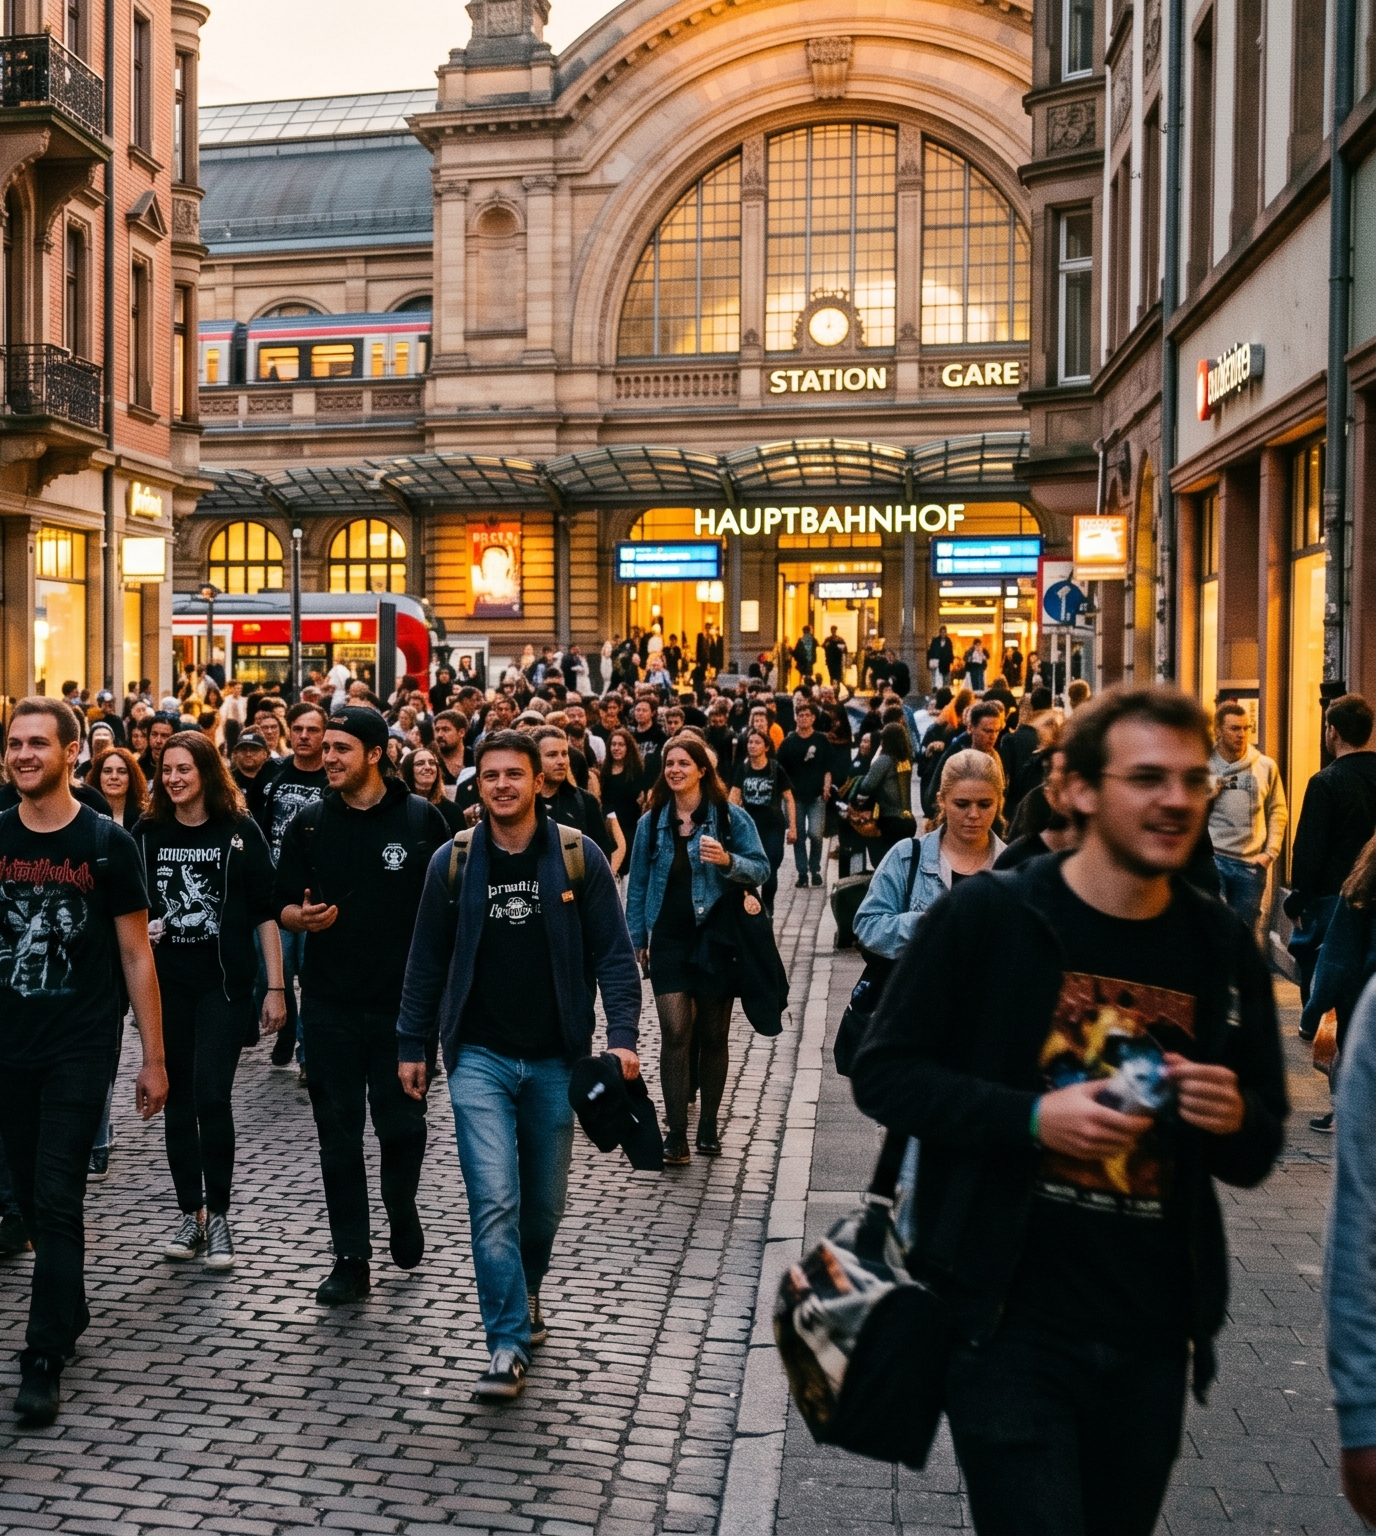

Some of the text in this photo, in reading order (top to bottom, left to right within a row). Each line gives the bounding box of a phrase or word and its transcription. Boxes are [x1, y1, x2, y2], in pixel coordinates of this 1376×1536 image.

[770, 367, 887, 393] STATION
[942, 362, 1020, 387] GARE
[694, 504, 965, 535] HAUPTBAHNHOF
